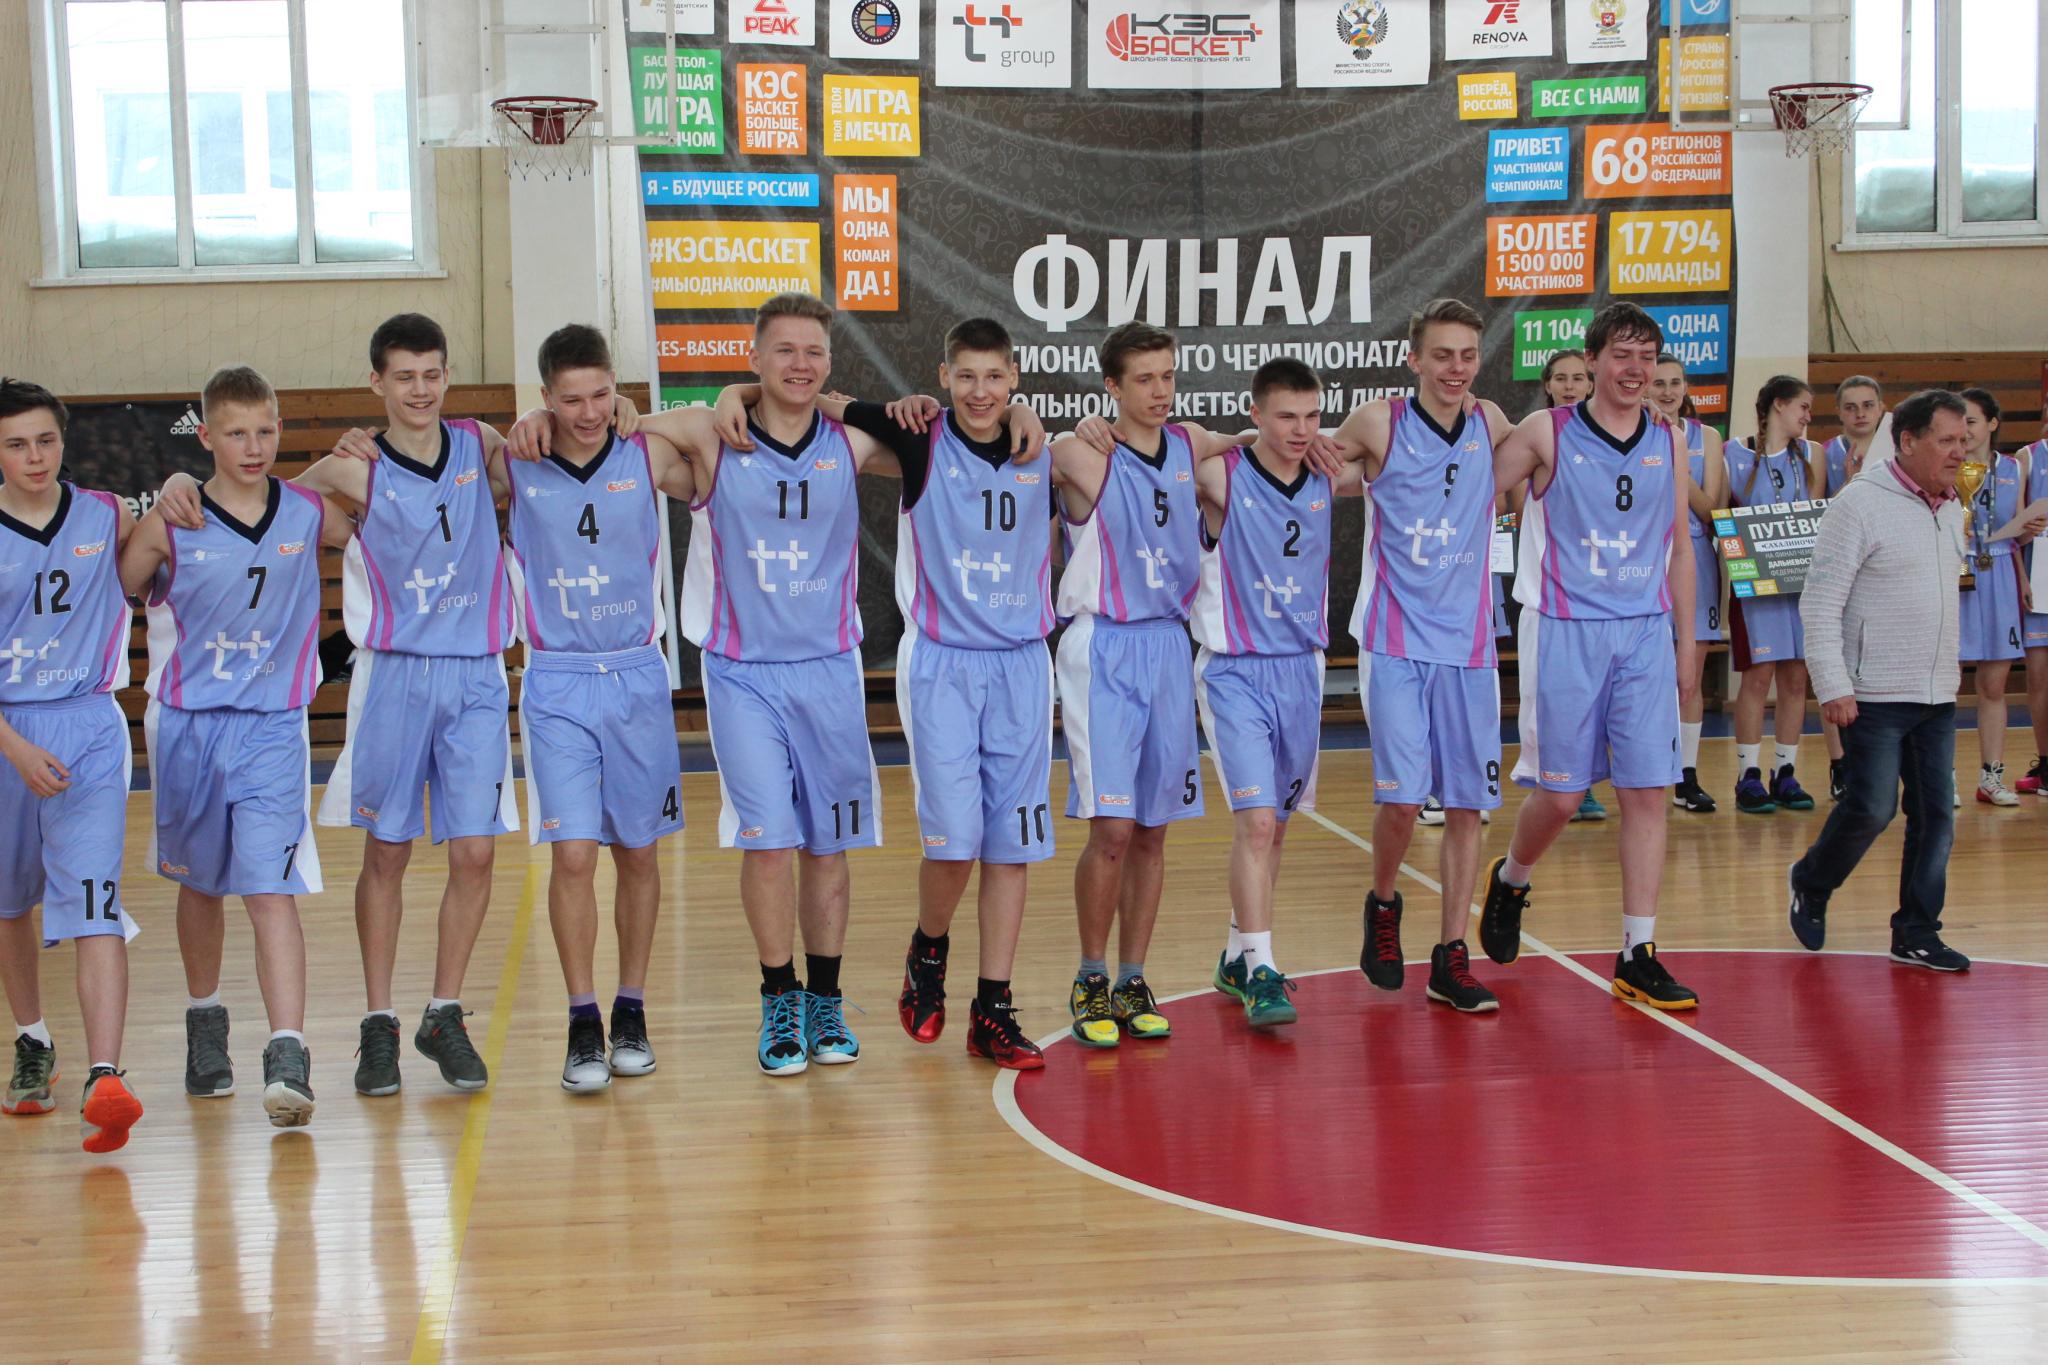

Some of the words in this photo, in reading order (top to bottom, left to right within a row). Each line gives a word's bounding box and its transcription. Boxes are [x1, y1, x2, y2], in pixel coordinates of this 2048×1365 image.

[744, 16, 799, 35] PEAK
[1130, 36, 1251, 56] БАСКЕТ
[1473, 31, 1528, 44] RENOVA
[643, 55, 706, 69] БАСТБОЛ
[1001, 50, 1055, 67] group
[643, 72, 714, 91] ЛУШАЯ
[745, 71, 798, 99] КЭС
[832, 87, 842, 115] ТВОЯ
[844, 88, 912, 115] ИГРА
[1463, 99, 1513, 112] РОССИЯ!
[1541, 88, 1571, 107] ВСЕ
[1574, 88, 1585, 106] С
[1589, 86, 1640, 105] НАМИ
[746, 101, 798, 116] БАСКЕТ
[746, 116, 803, 132] БОЛЬШЕ,
[833, 120, 842, 142] ТВОЯ
[845, 121, 912, 142] МЕЧТА
[755, 131, 799, 149] ИГРА
[1493, 136, 1563, 157] ПРИВЕТ
[1651, 135, 1722, 150] РЕГИОНОВ
[1591, 136, 1648, 185] 68
[1651, 150, 1722, 165] РОССИЙСКОЙ
[1493, 163, 1564, 175] УЧАСТНИКАМ
[1651, 167, 1722, 183] ФЕДЕРАЦИИ
[647, 181, 658, 196] Я
[673, 179, 744, 198] БУДУЩЕЕ
[747, 180, 810, 197] РОССИИ
[1491, 180, 1563, 193] ЧЕМПИОНАТА!
[842, 187, 889, 214] МЫ
[842, 220, 889, 240] ОДНА
[1497, 221, 1588, 251] БОЛЕЕ
[1617, 221, 1653, 255] 17
[1660, 220, 1720, 255] 794
[649, 237, 810, 264] #КЭСБАСКЕТ
[843, 249, 890, 262] КОМАН
[1550, 252, 1584, 271] 000
[1013, 234, 1372, 332] ФИНАЛ
[1496, 274, 1584, 291] УЧАСТНИКОВ
[1618, 262, 1721, 285] КОМАНДЫ
[652, 276, 810, 296] #МЫОДНАКОМАНДА
[1522, 320, 1542, 342] 11
[1667, 313, 1720, 338] ОДНА
[656, 340, 754, 356] KES-BASKET.
[776, 480, 808, 519] 11
[1615, 474, 1632, 512] 8
[1979, 488, 1991, 511] 4
[981, 489, 1016, 532] 10
[1154, 488, 1168, 528] 5
[436, 502, 452, 543] 1
[576, 503, 600, 544] 4
[1283, 519, 1301, 557] 2
[1724, 539, 1740, 551] 68
[34, 568, 71, 615] 12
[247, 566, 267, 610] 7
[789, 578, 828, 597] group
[591, 599, 637, 621] group
[989, 591, 1027, 608] group
[1708, 606, 1718, 631] 8
[2009, 626, 2020, 650] 4
[37, 666, 89, 686] group
[1183, 769, 1197, 806] 5
[1486, 759, 1500, 796] 9
[662, 785, 679, 821] 4
[1283, 778, 1303, 810] 2
[831, 800, 860, 840] 11
[282, 842, 299, 881] 7
[81, 877, 118, 922] 12
